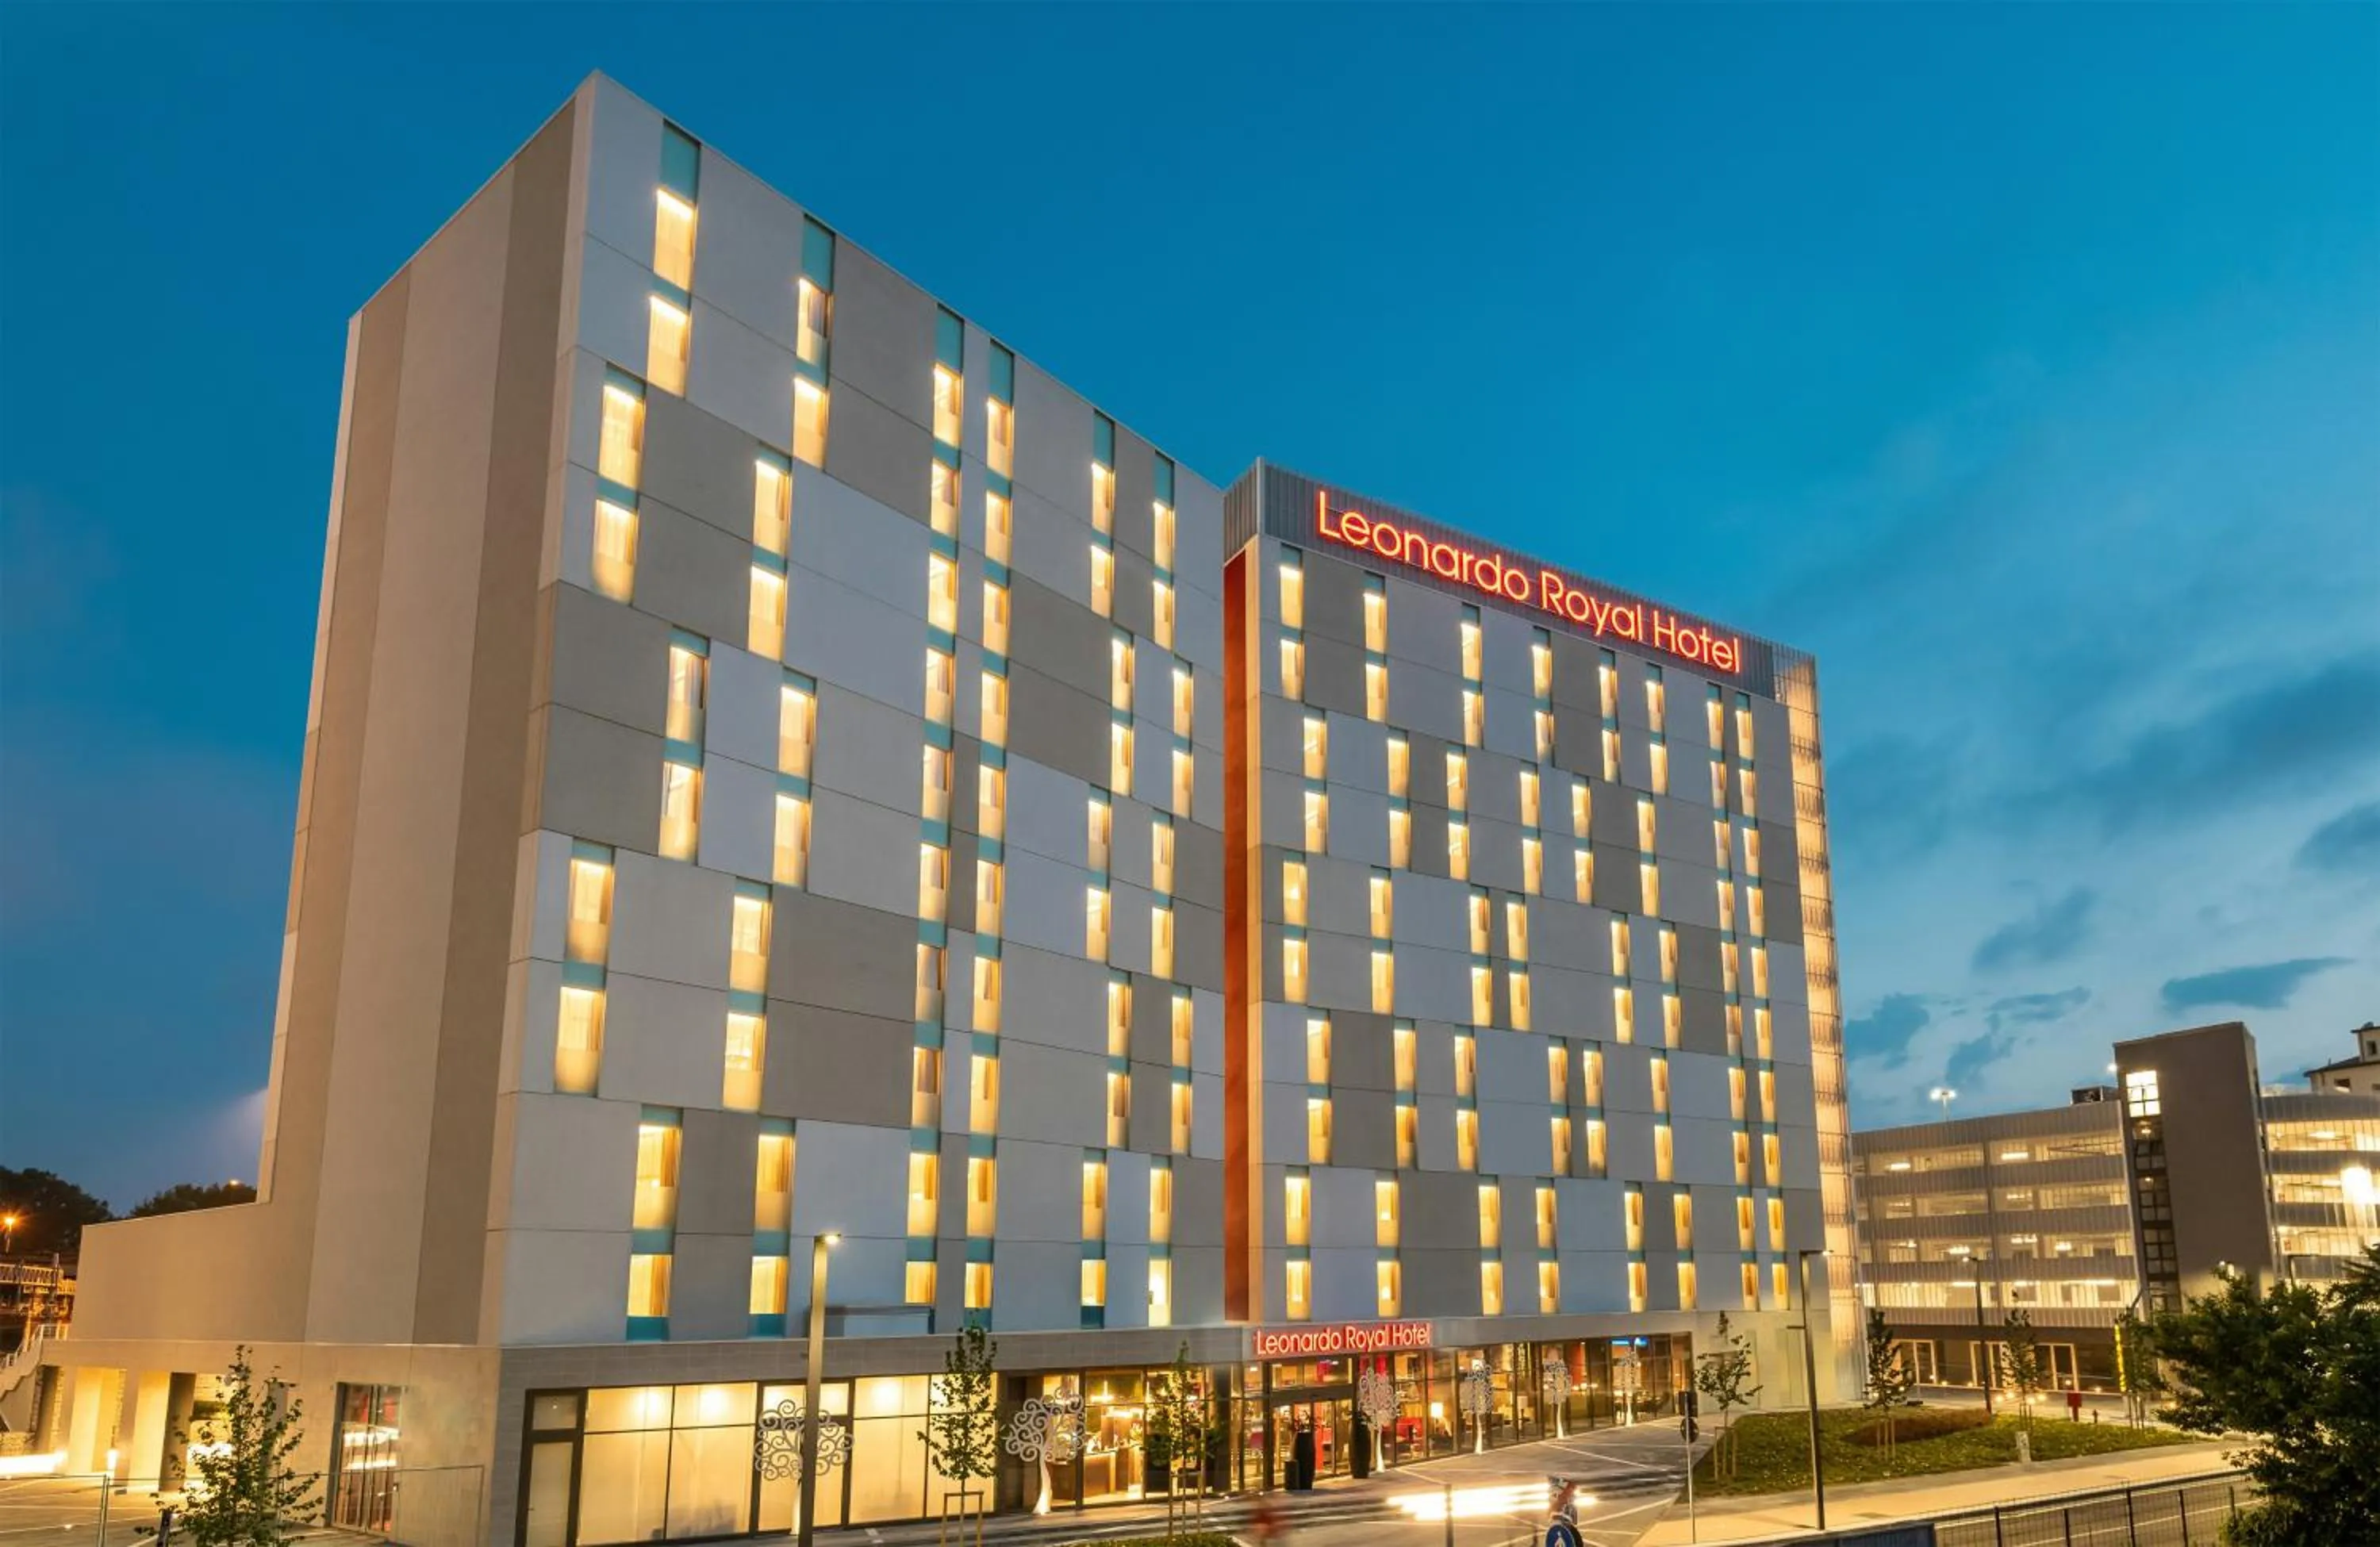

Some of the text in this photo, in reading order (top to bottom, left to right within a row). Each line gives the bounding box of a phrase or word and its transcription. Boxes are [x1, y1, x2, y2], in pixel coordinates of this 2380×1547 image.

[1318, 489, 1741, 673] Leonardo Royal Hotel
[1257, 1322, 1431, 1354] Leonardo Royal Hotel
